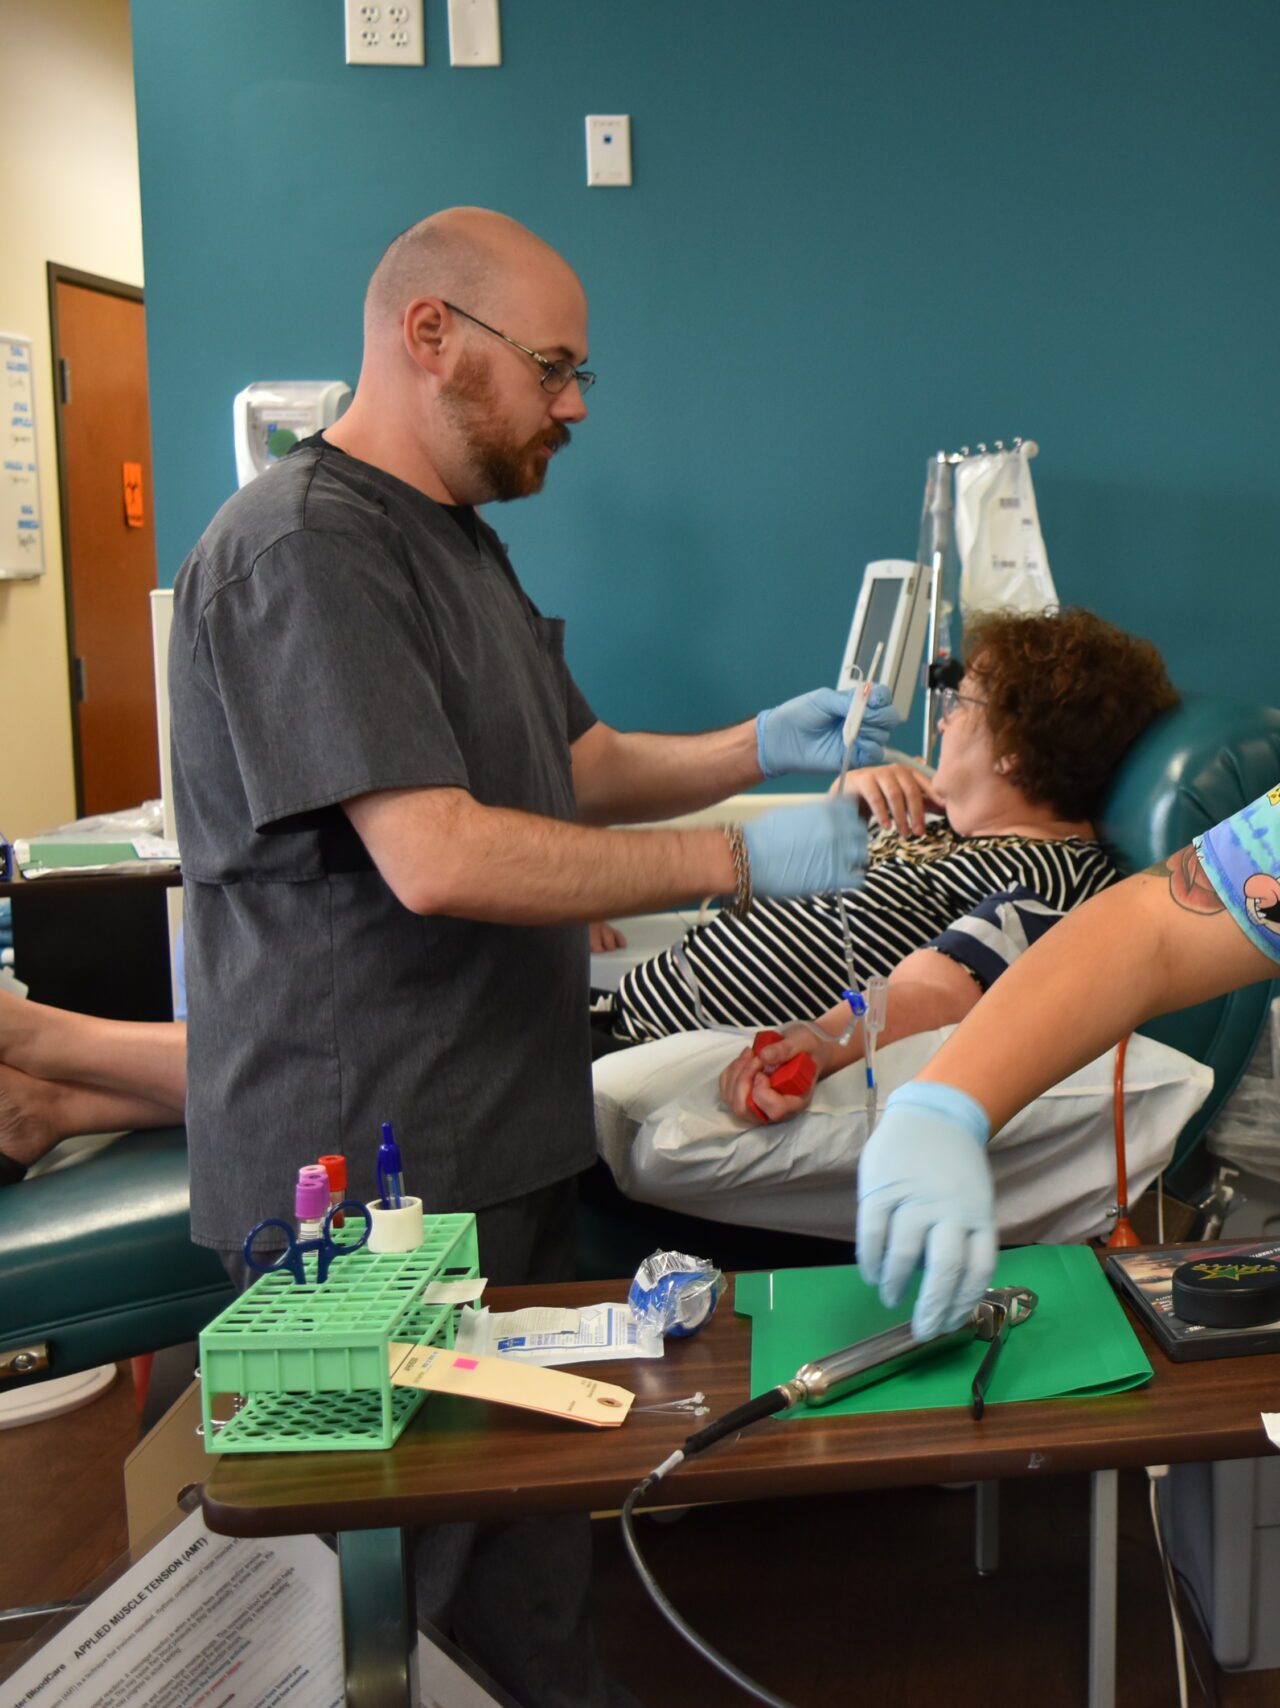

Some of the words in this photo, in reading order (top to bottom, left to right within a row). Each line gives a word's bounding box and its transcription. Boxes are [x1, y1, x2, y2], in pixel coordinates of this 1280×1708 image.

[73, 1623, 112, 1659] APPLIED
[108, 1590, 146, 1625] MUSCLE
[144, 1557, 183, 1594] TENSION
[181, 1535, 208, 1562] (AMT)
[25, 1662, 67, 1699] BloodCare
